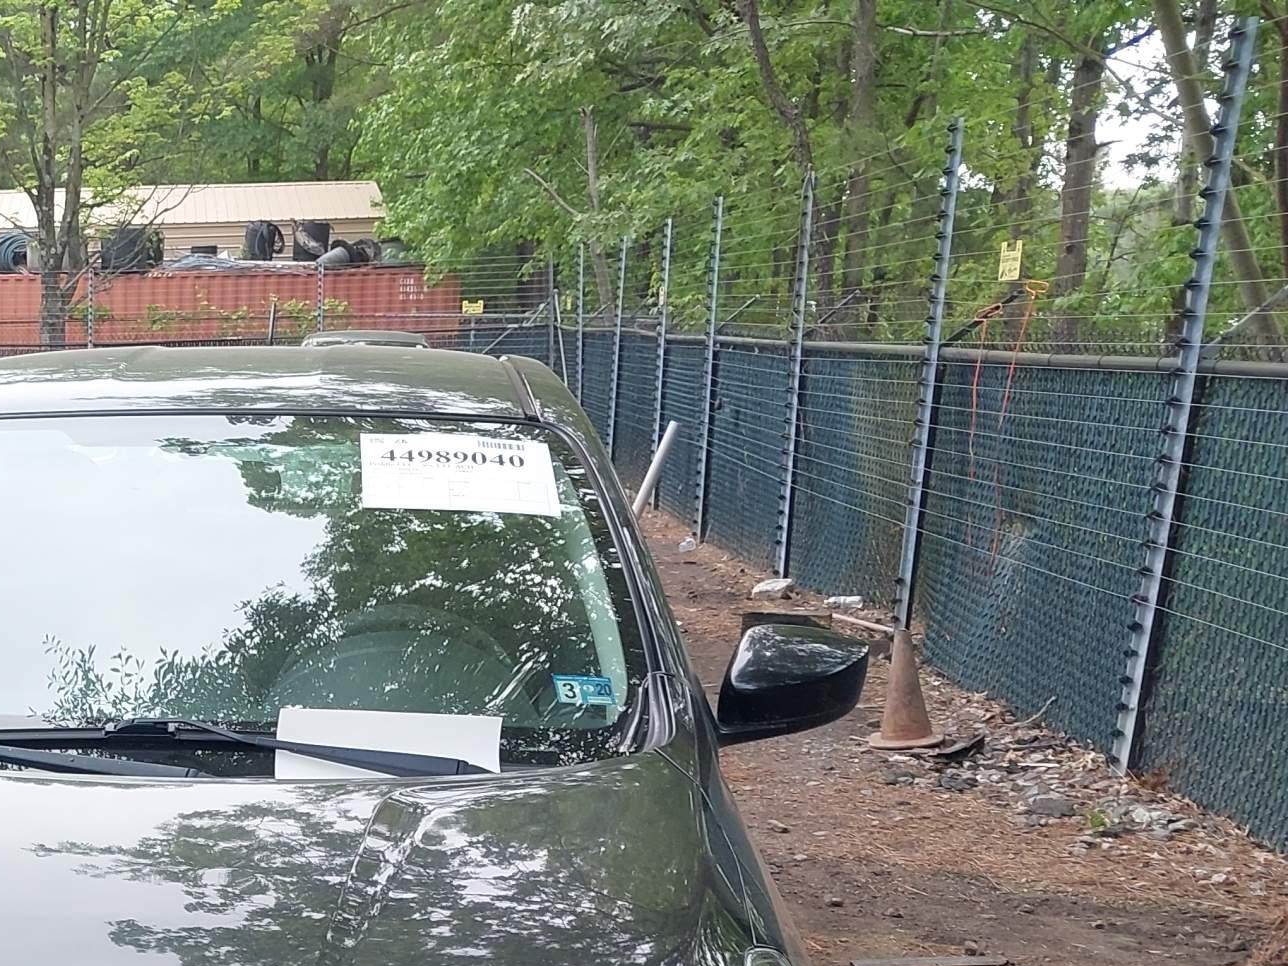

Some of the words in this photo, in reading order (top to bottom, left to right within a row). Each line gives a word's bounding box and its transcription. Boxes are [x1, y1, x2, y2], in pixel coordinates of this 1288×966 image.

[381, 449, 525, 467] 44989040
[562, 682, 577, 699] 3
[595, 683, 612, 696] 20
